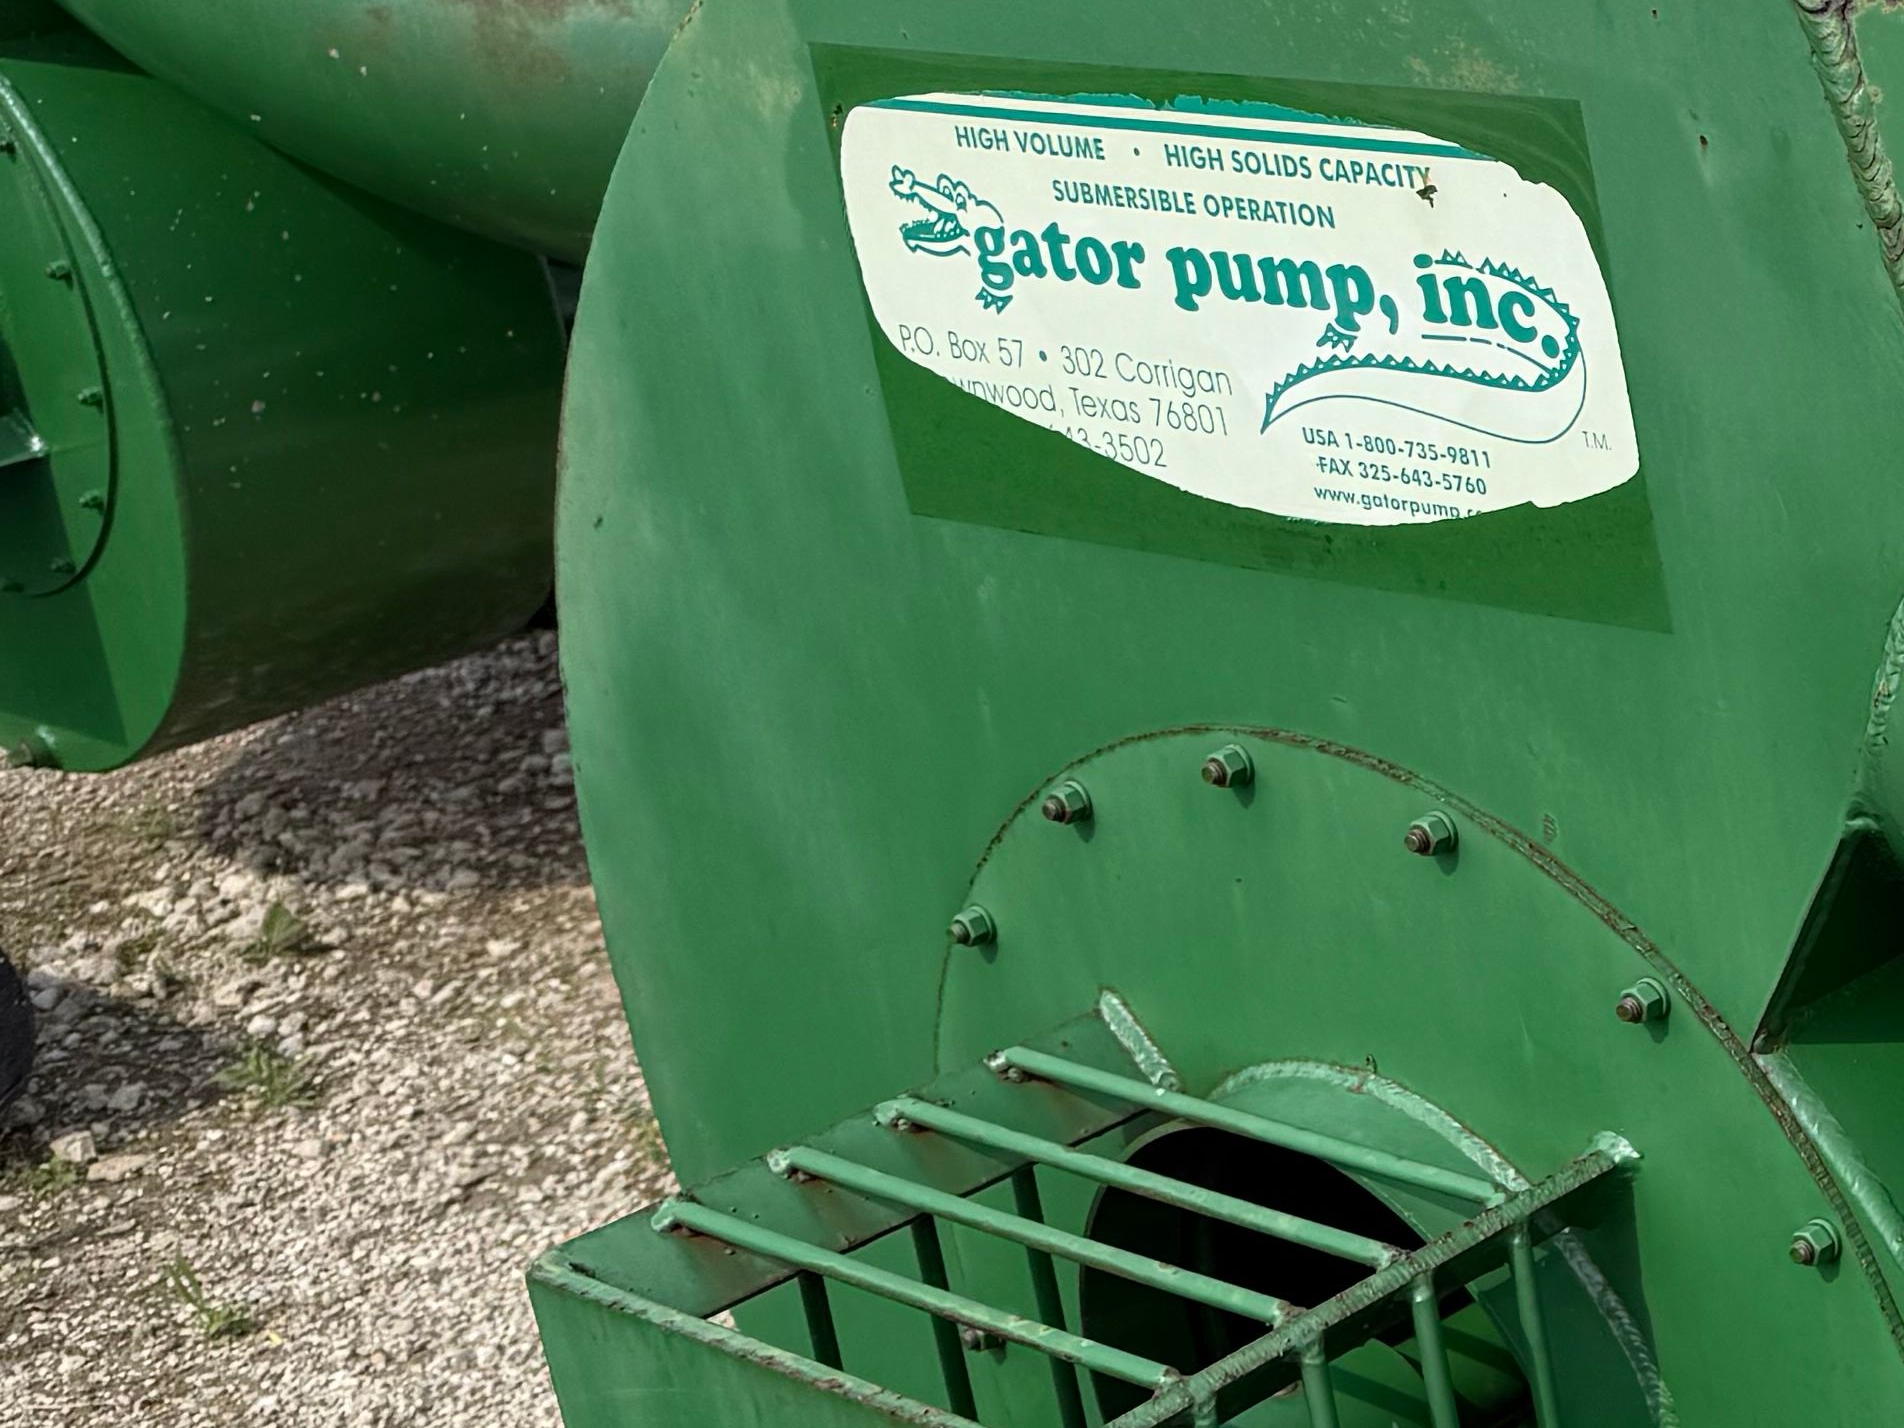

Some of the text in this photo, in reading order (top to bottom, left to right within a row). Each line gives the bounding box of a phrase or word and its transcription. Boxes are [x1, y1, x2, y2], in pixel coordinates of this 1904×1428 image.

[954, 125, 1431, 190] HIGH VOLUME HIGH SOLIDS CAPACITY
[1052, 179, 1336, 229] SUBMERSIBLE OPERATION
[973, 222, 1560, 359] gator pump, inc.
[898, 324, 1233, 398] P.O. Box 57 302 Corrigan
[1068, 386, 1141, 423] Texas
[1148, 397, 1228, 437] 76801
[1301, 426, 1491, 469] USA 1-800-735-9811
[1317, 455, 1487, 496] FAX 325-643-5760
